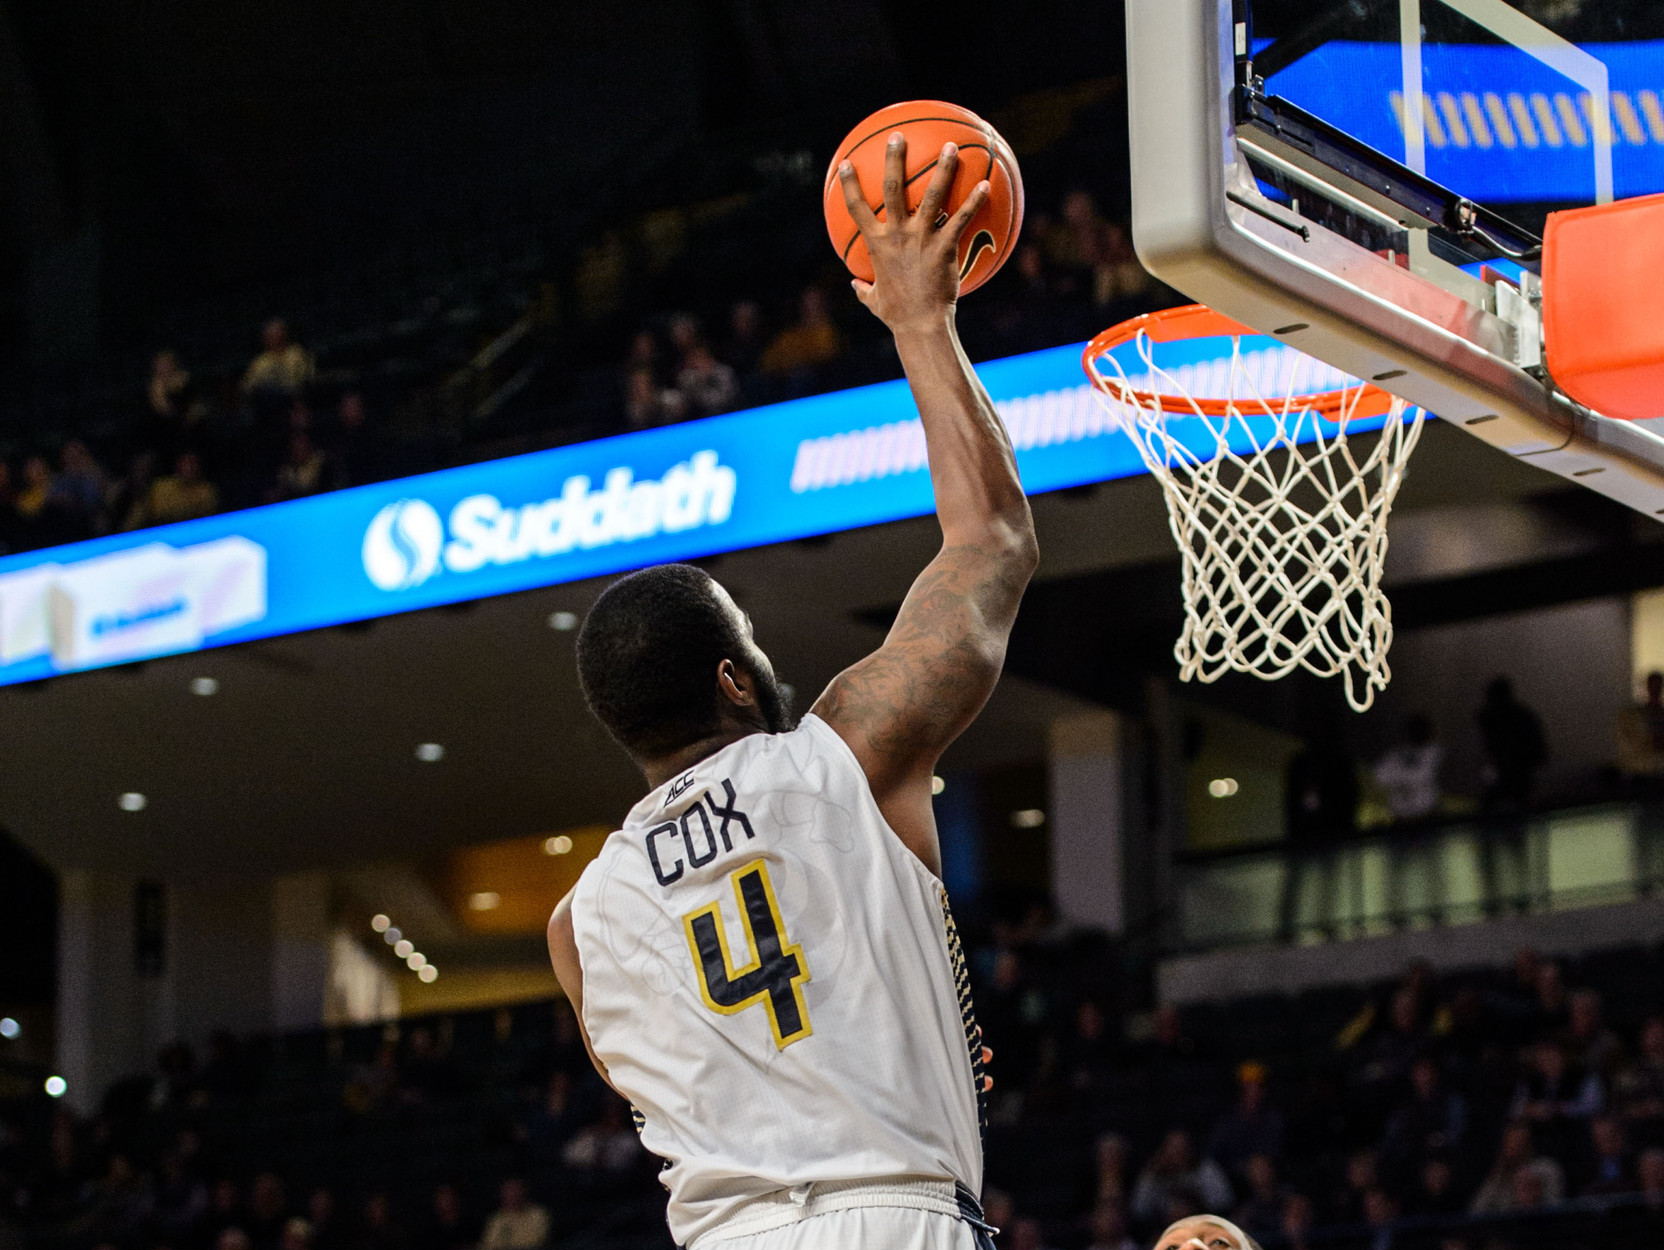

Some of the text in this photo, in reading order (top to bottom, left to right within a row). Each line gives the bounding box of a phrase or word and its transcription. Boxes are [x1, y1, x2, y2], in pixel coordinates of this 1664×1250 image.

[445, 450, 736, 573] Suddath
[645, 777, 755, 887] COX
[663, 770, 695, 808] ACC
[681, 858, 813, 1052] 4
